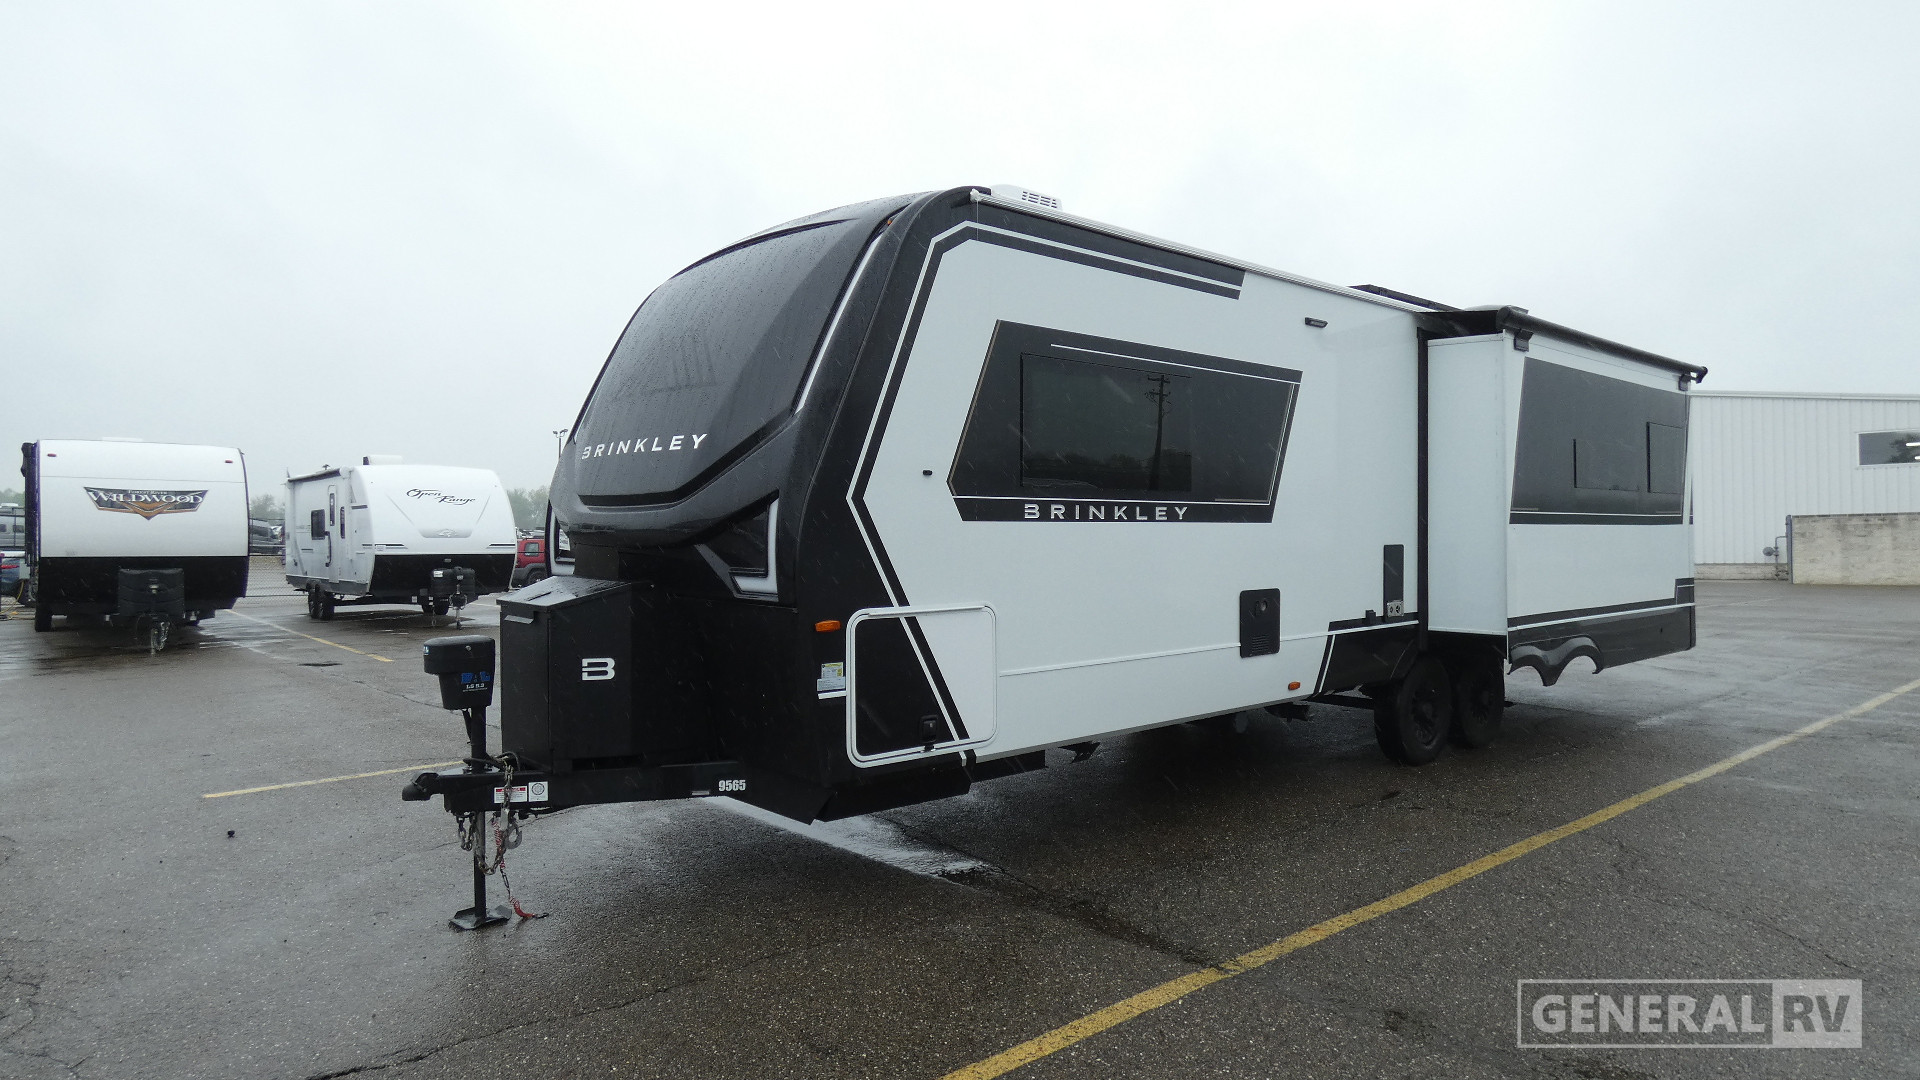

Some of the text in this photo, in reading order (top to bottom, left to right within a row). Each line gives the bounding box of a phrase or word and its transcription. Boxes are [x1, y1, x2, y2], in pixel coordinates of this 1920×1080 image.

[581, 433, 708, 460] BRINKLEY
[88, 491, 203, 504] WILDWOOD
[406, 488, 442, 499] Open
[1024, 503, 1188, 521] BRINKLEY
[581, 657, 616, 681] B
[718, 779, 746, 792] 9565
